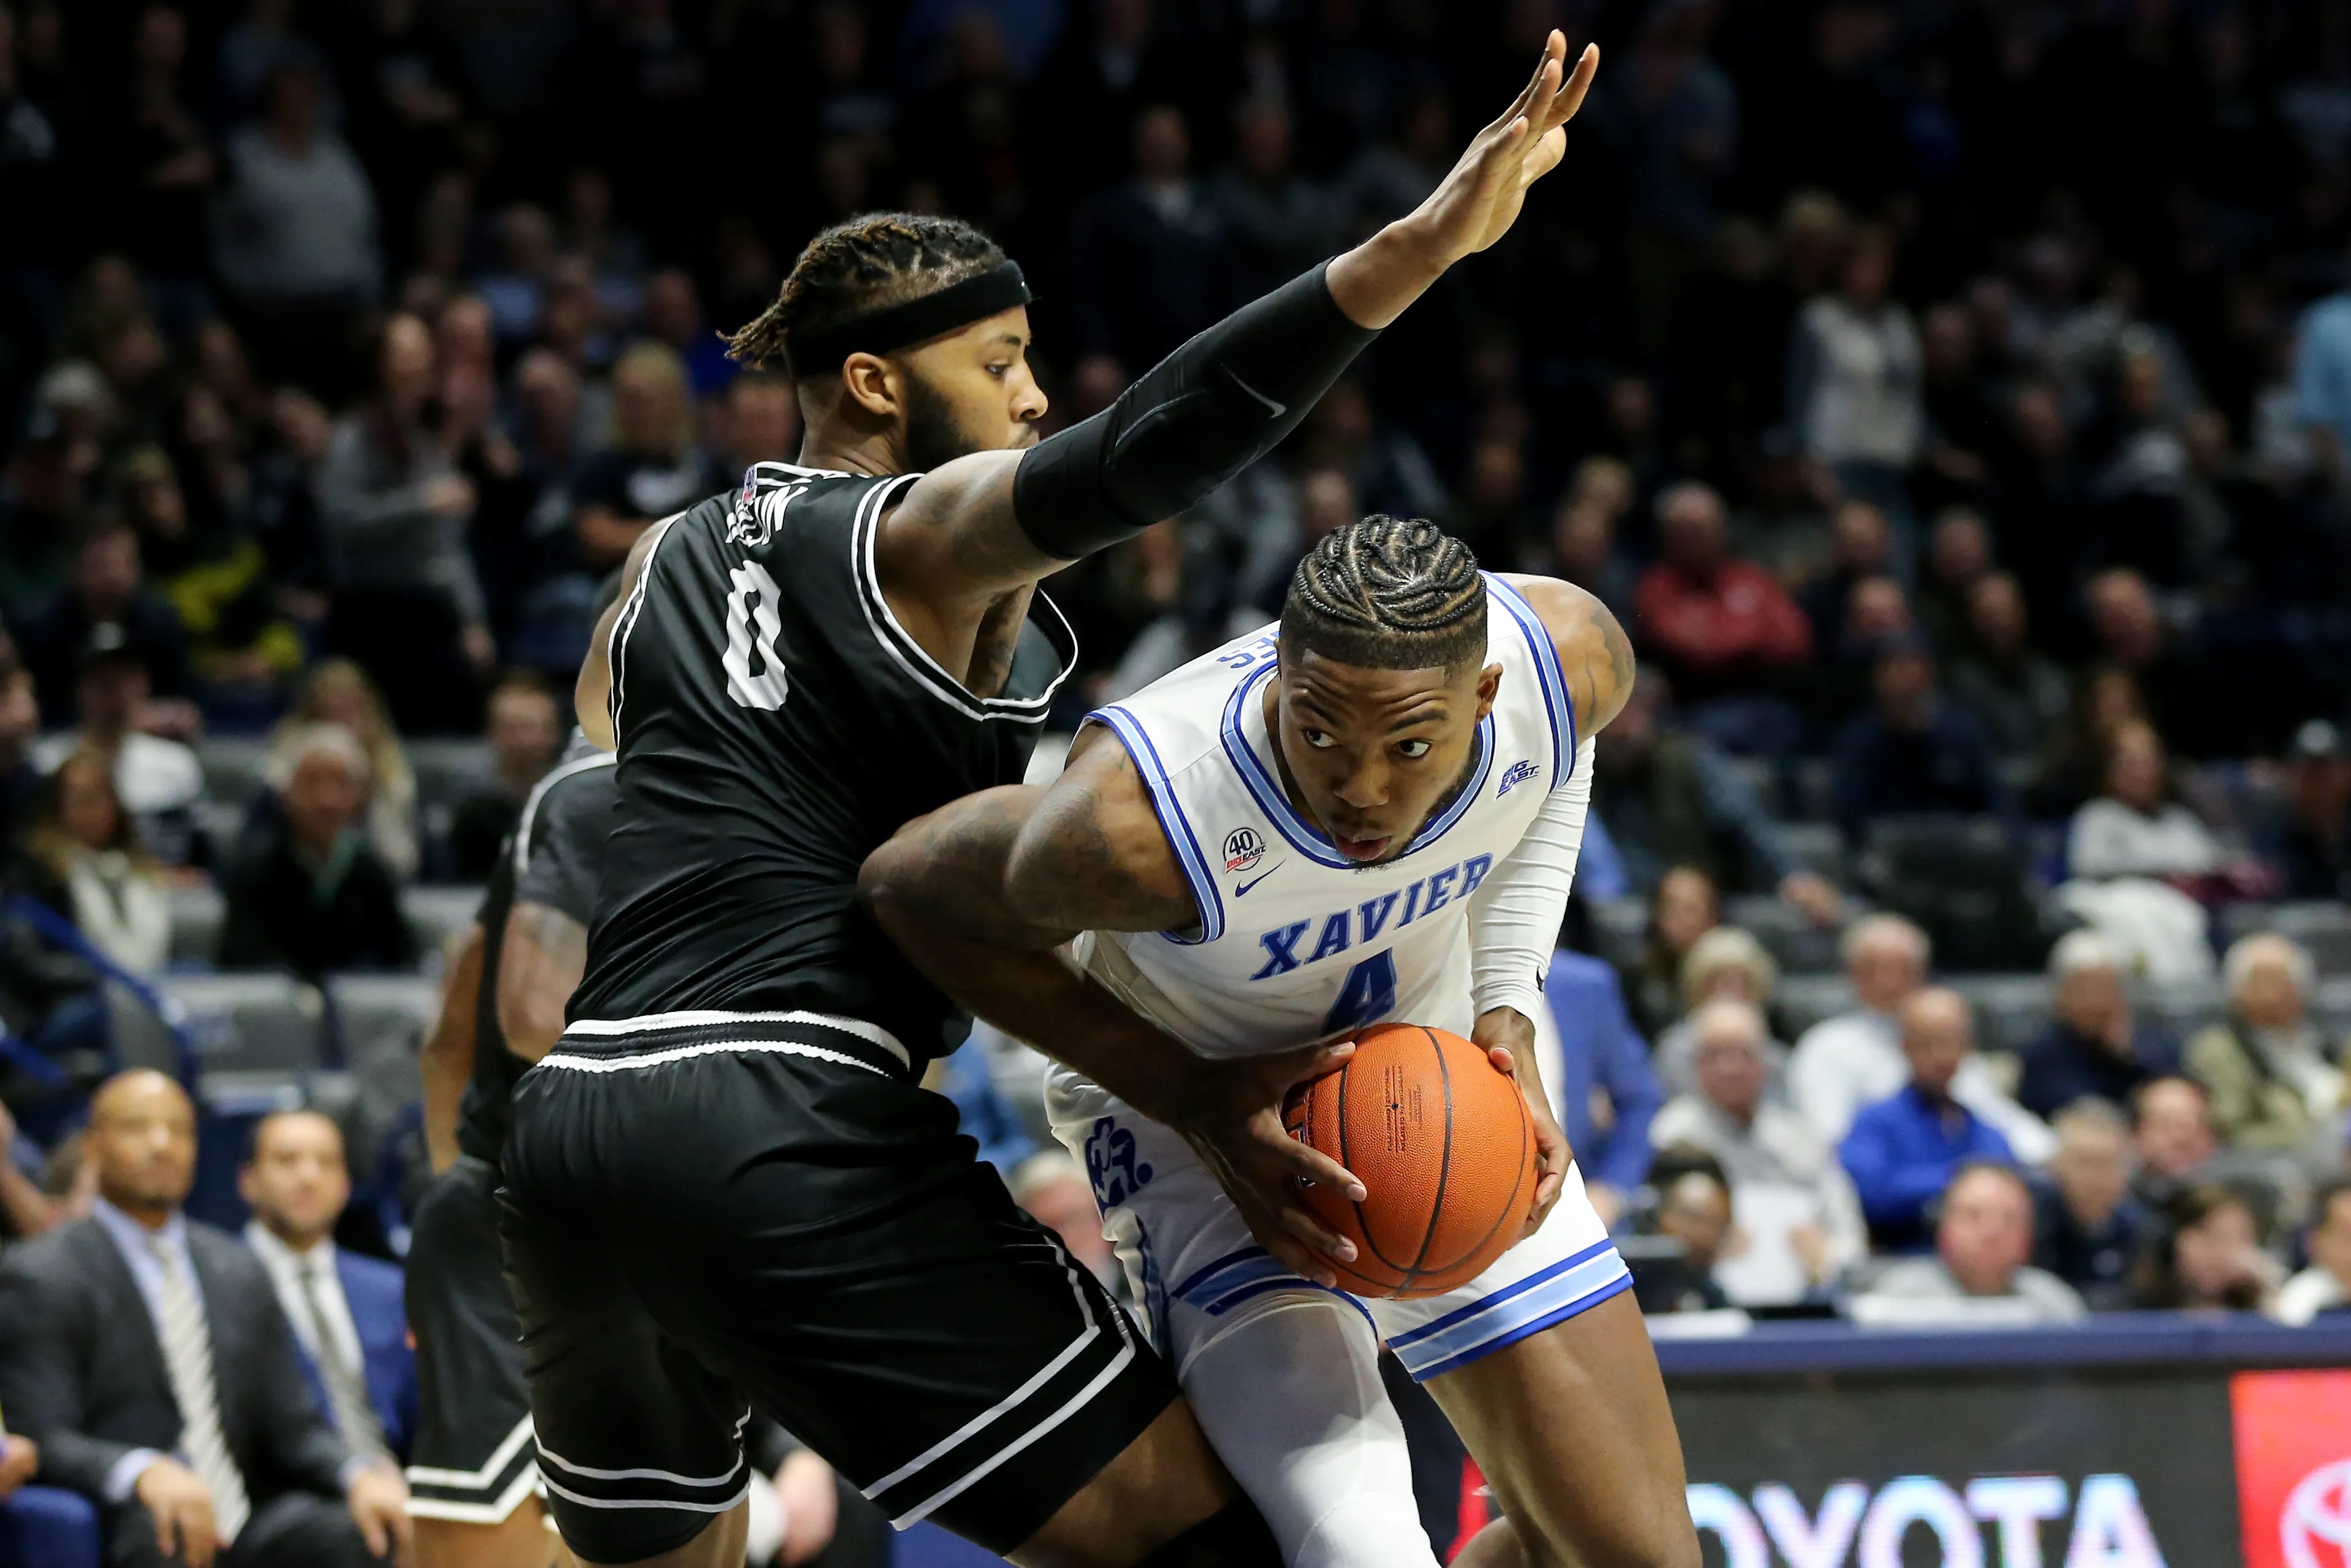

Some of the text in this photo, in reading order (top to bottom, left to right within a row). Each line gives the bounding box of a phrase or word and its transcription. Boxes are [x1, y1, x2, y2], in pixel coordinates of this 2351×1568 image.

[721, 558, 789, 711] 0
[1229, 830, 1254, 855] 40
[1242, 844, 1266, 861] EAST
[1249, 852, 1494, 981] XAVIER
[1323, 947, 1397, 1036] 4
[1686, 1474, 2168, 1568] YOTA
